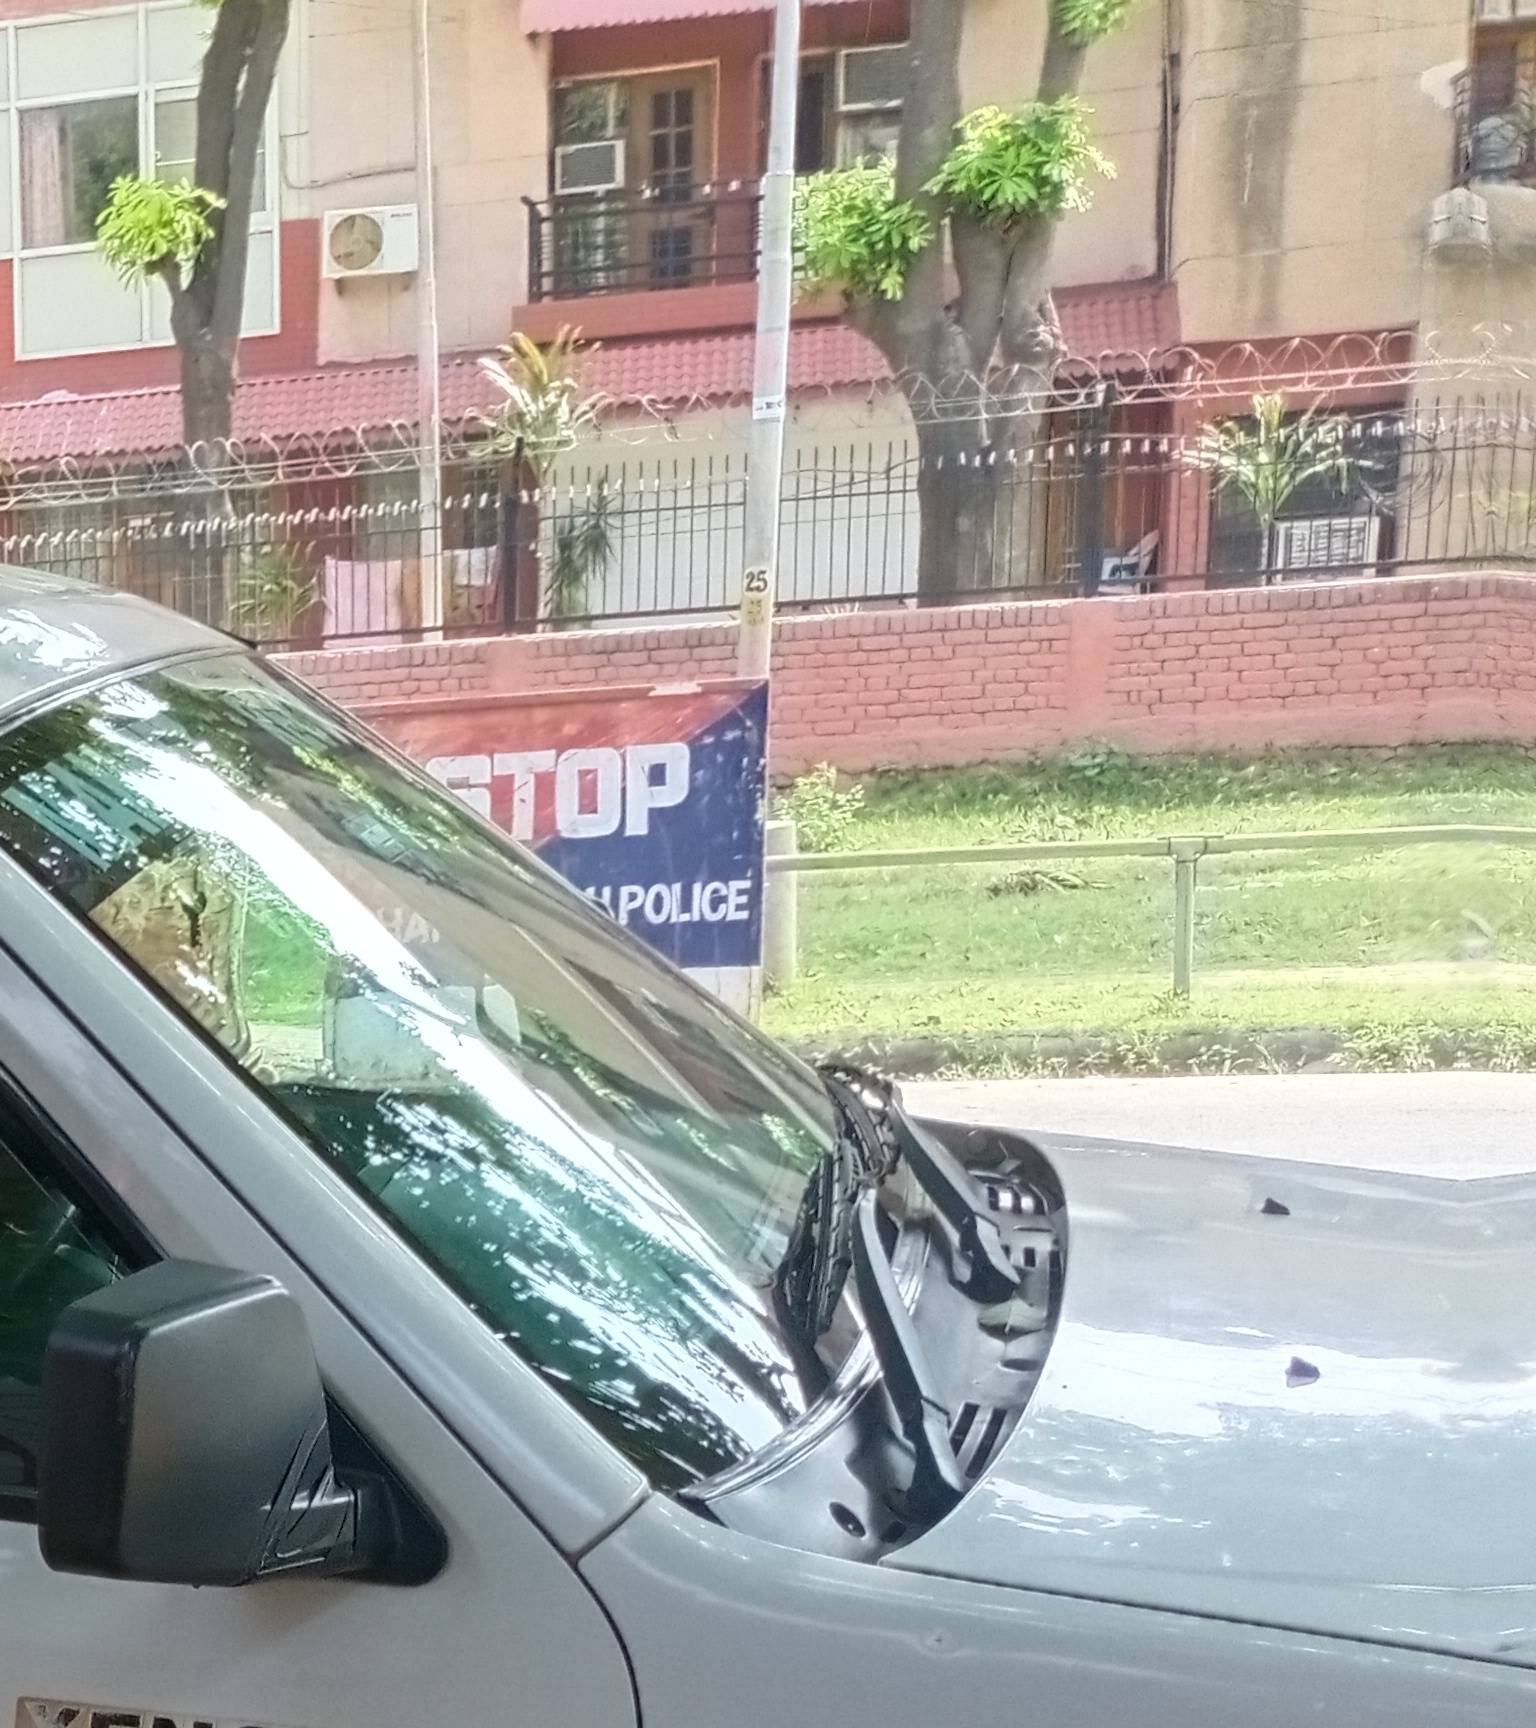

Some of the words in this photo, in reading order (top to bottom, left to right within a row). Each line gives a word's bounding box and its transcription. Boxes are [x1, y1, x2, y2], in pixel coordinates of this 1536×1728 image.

[745, 569, 768, 593] 25
[425, 741, 691, 842] STOP
[618, 879, 752, 926] POLICE
